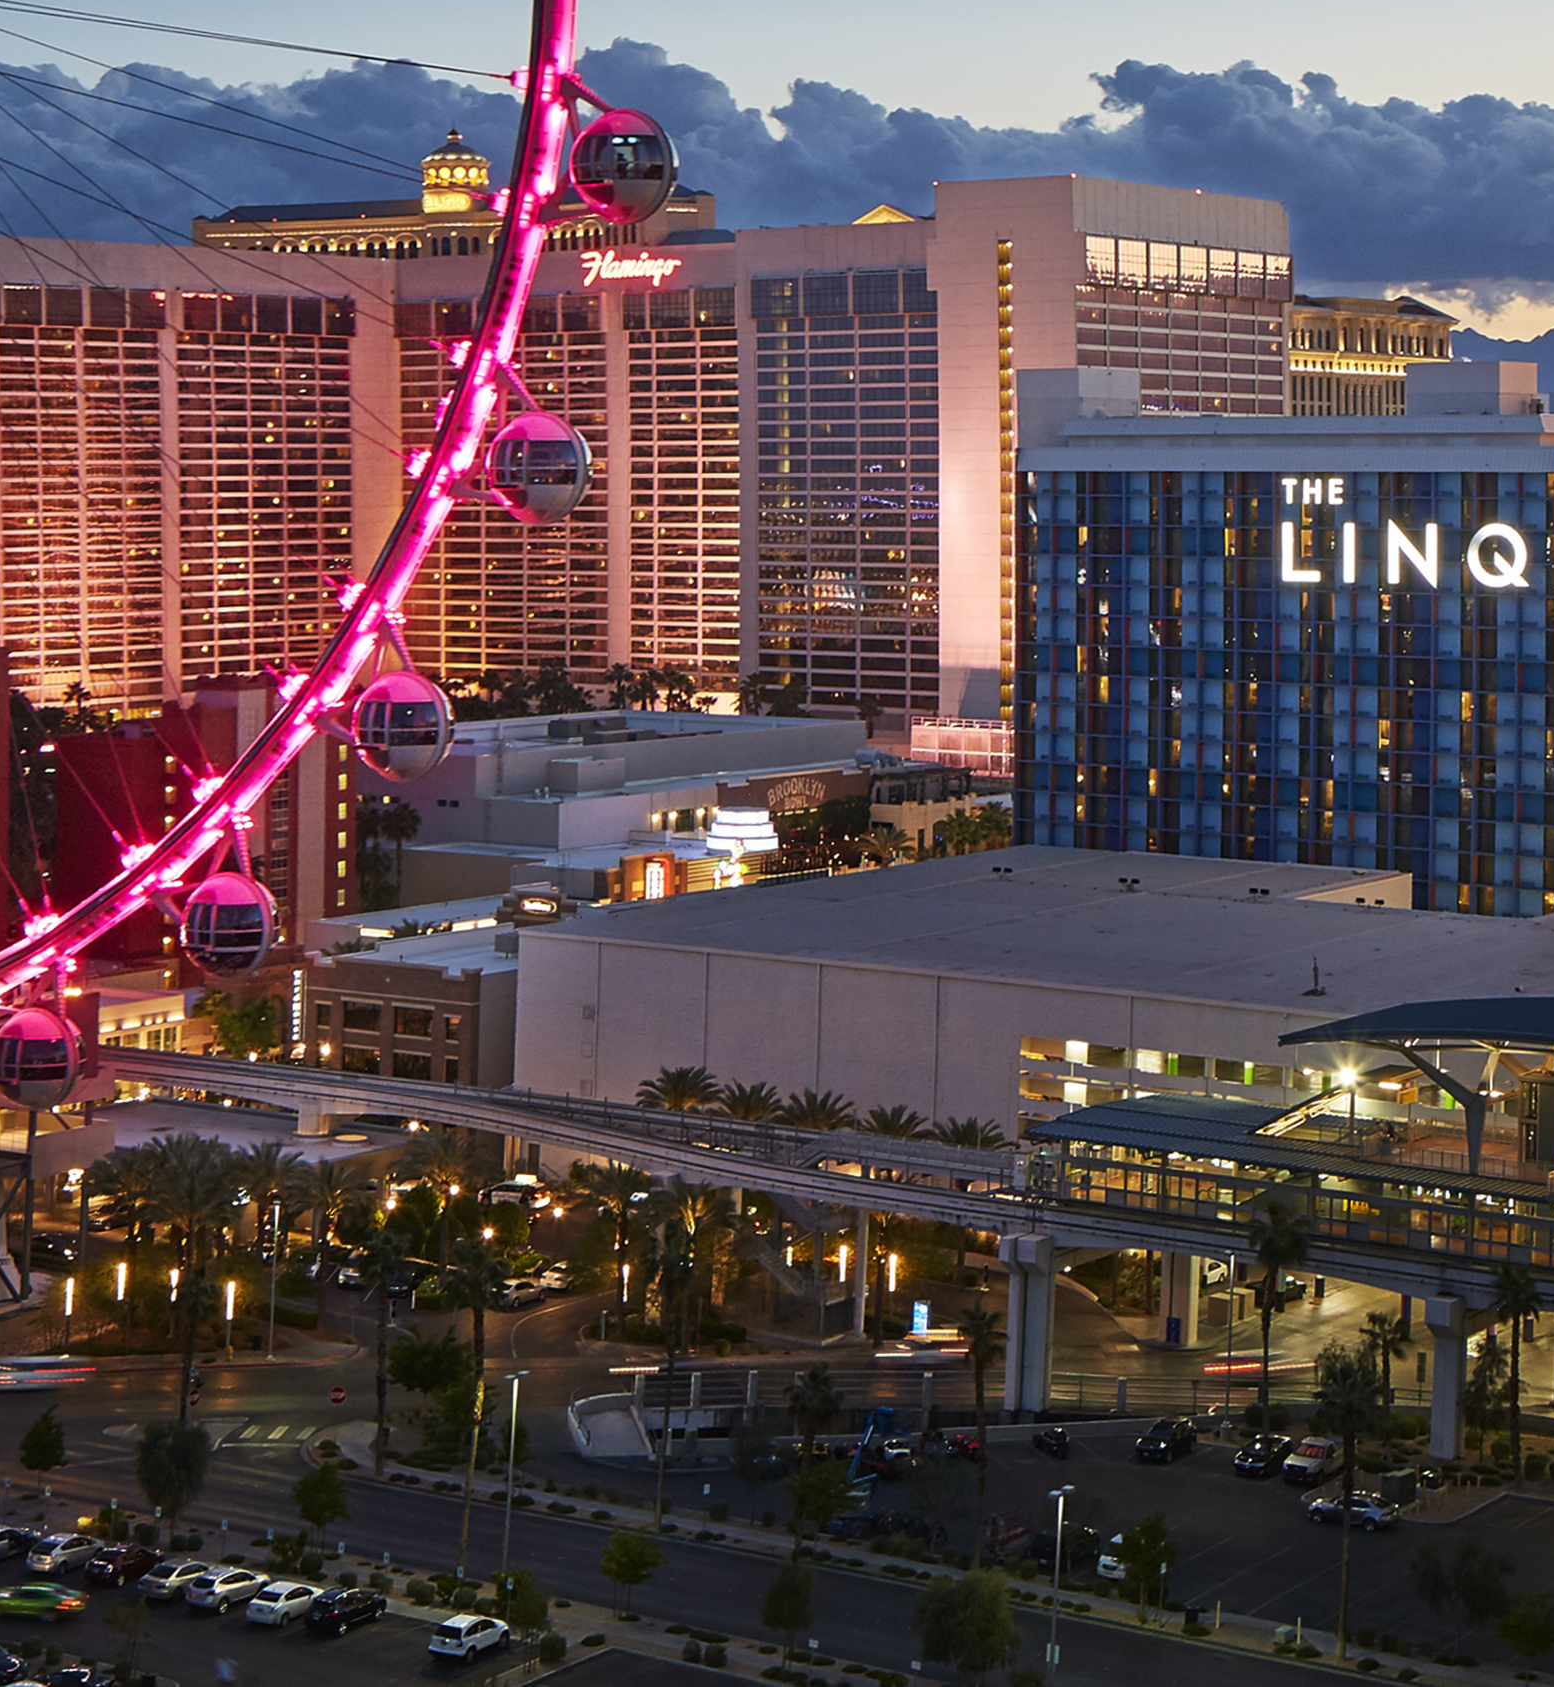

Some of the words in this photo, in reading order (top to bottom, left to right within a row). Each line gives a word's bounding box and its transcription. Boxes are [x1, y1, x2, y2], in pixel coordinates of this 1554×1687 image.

[580, 250, 682, 287] Flamingo
[1281, 478, 1344, 505] THE
[1281, 518, 1530, 590] LINQ
[767, 777, 826, 807] BROOKLYN
